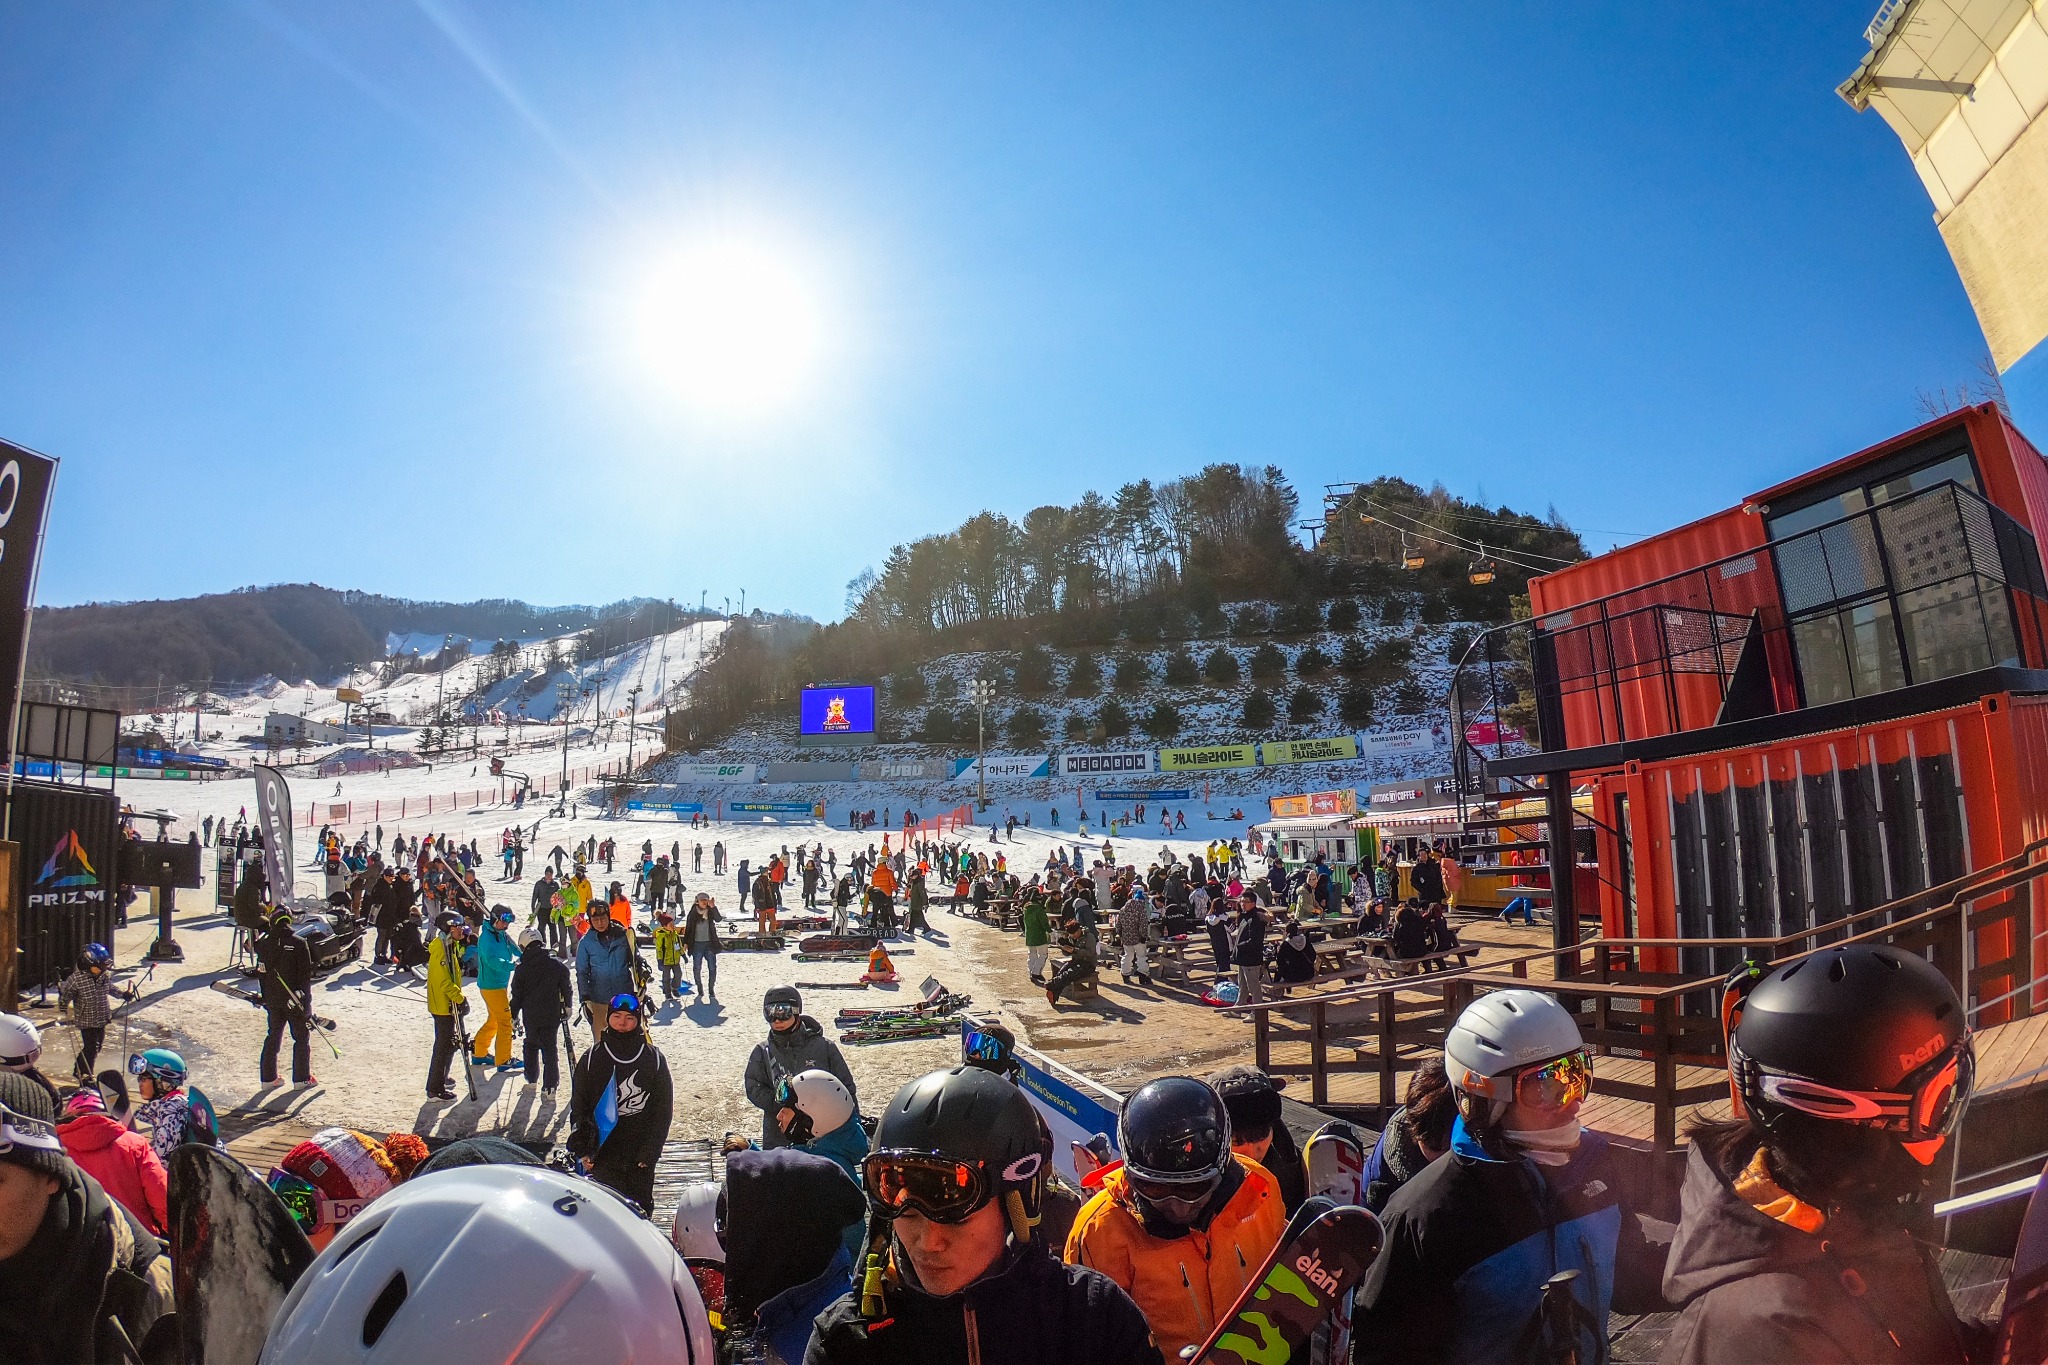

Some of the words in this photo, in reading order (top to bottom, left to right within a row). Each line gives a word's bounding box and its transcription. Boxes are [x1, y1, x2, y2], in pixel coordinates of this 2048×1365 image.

[1371, 735, 1402, 743] SAMSUNG
[1403, 732, 1421, 741] pay
[1068, 757, 1145, 769] MEGABOX
[1173, 750, 1244, 765] 캐시슬라이드
[718, 766, 744, 776] BGF
[881, 765, 924, 779] FUBU
[989, 764, 1030, 776] 하나카드
[1398, 790, 1416, 801] COFFEE
[28, 889, 106, 908] PRIZM
[860, 929, 896, 938] SPREAD
[1899, 1033, 1945, 1071] bern
